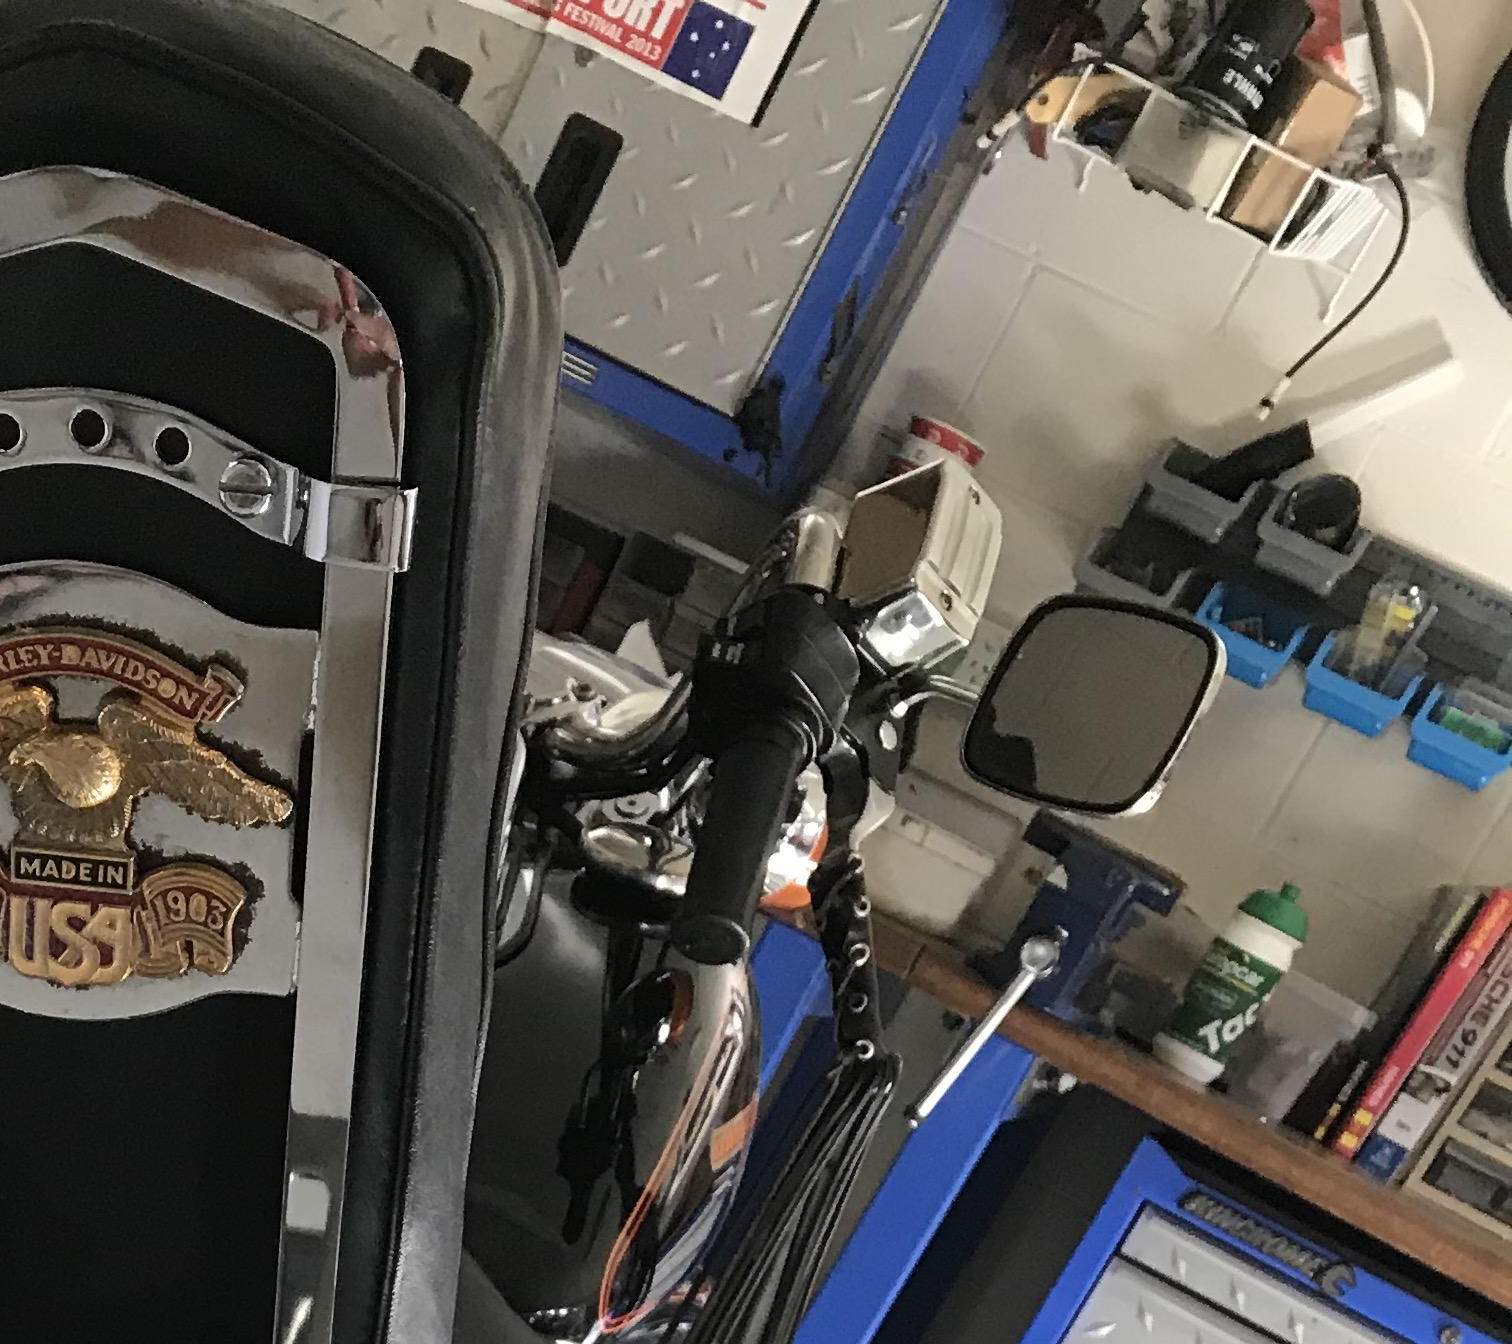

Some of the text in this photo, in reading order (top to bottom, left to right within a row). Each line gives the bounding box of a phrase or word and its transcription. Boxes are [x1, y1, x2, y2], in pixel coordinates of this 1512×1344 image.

[563, 2, 662, 60] FESTIVAL 2013
[19, 856, 125, 886] MADE IN
[157, 889, 227, 930] 1903
[9, 894, 135, 986] USA
[1445, 1028, 1478, 1069] 911
